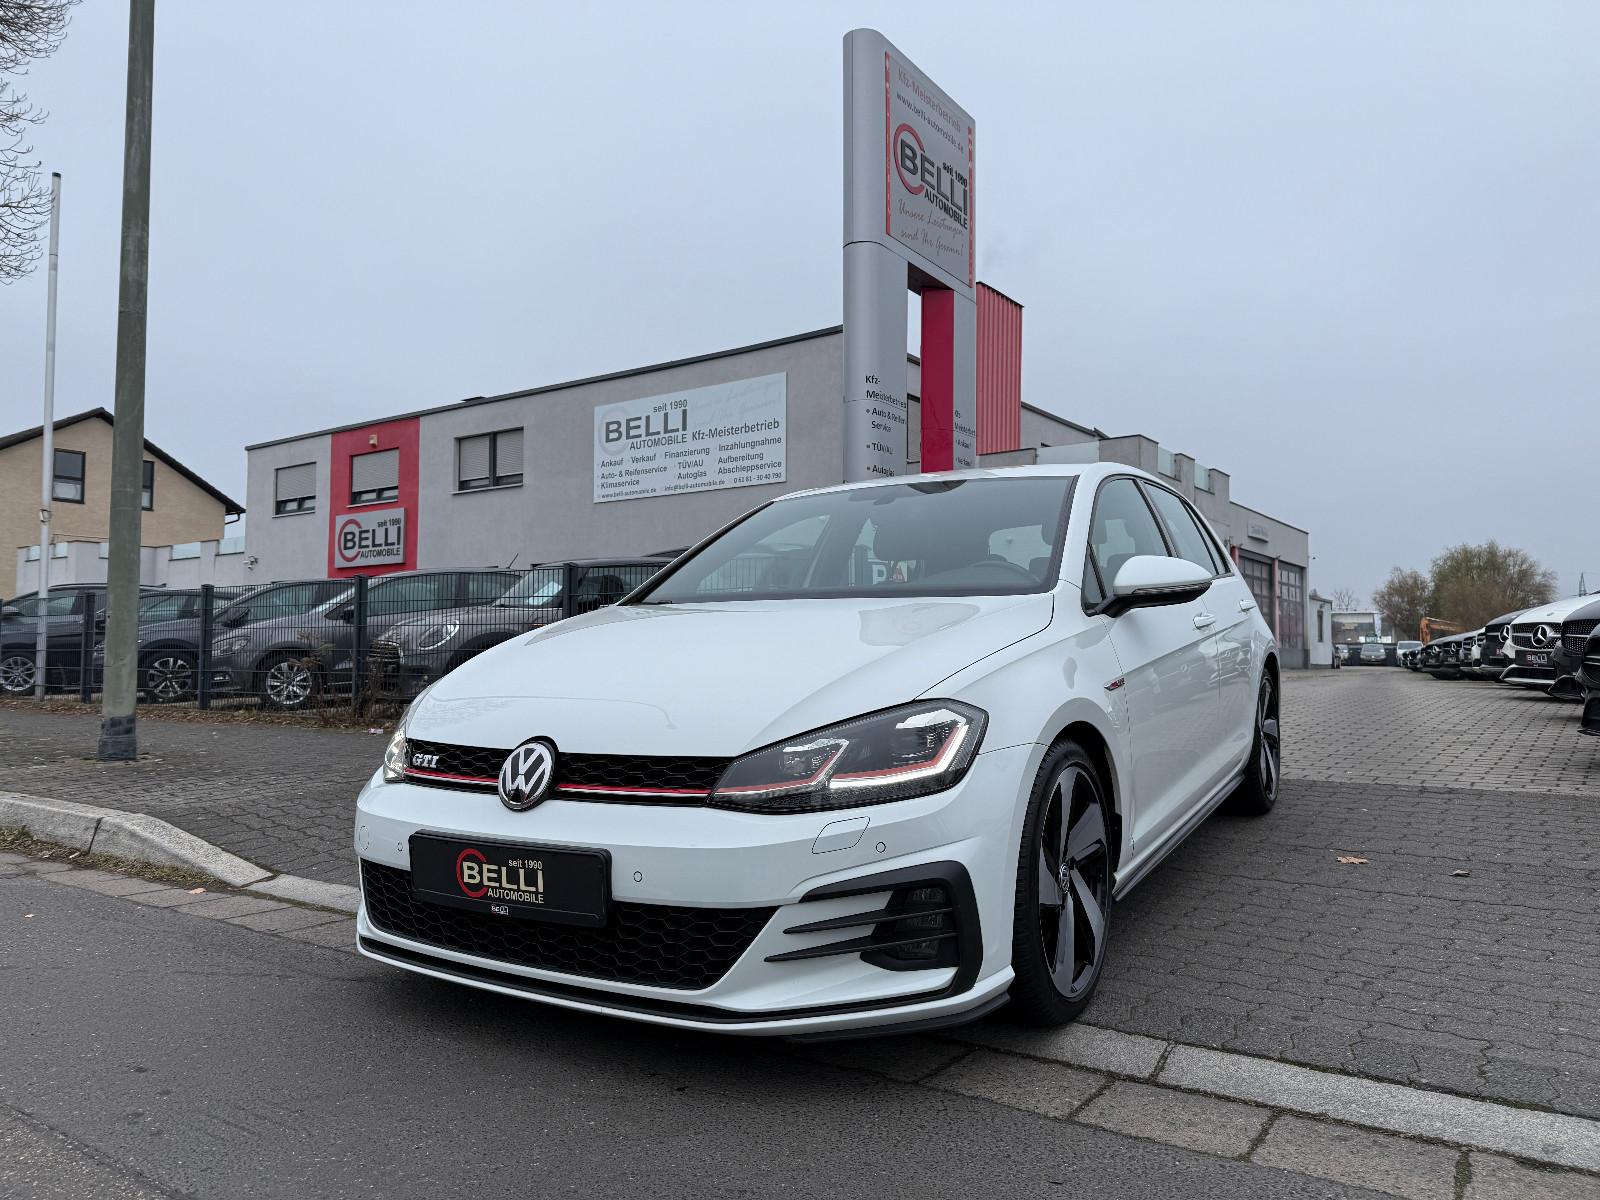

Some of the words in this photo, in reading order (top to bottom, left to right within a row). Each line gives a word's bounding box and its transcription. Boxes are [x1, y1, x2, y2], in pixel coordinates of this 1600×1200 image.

[900, 138, 968, 216] BELLI
[942, 161, 954, 177] seit
[924, 187, 968, 230] AUTOMOBILE
[865, 374, 881, 385] Kfz-
[653, 402, 667, 414] seit
[669, 399, 688, 410] 1990
[604, 408, 688, 444] BELLI
[691, 417, 780, 442] Kfz-Meisterbetrieb
[600, 457, 624, 469] Ankauf
[630, 453, 657, 465] Verkauf
[664, 446, 711, 461] Finanzierung
[718, 436, 782, 452] Inzahlungnahme
[629, 433, 688, 451] AUTOMOBILE
[600, 470, 618, 481] Auto-
[618, 470, 624, 478] &
[624, 465, 668, 478] Reifenservice
[677, 459, 704, 471] TÜV/AU
[717, 451, 764, 466] Aufbereitung
[600, 478, 640, 490] Klimaservice
[677, 469, 708, 481] Autoglas
[717, 460, 782, 476] Abschleppservice
[377, 520, 388, 528] seit
[388, 517, 402, 527] 1990
[343, 526, 402, 551] BELLI
[360, 547, 401, 559] AUTOMOBILE
[412, 753, 440, 769] GTI
[508, 858, 523, 869] seit
[524, 859, 543, 870] 1990
[462, 861, 544, 893] BELLI
[487, 887, 545, 904] AUTOMOBILE
